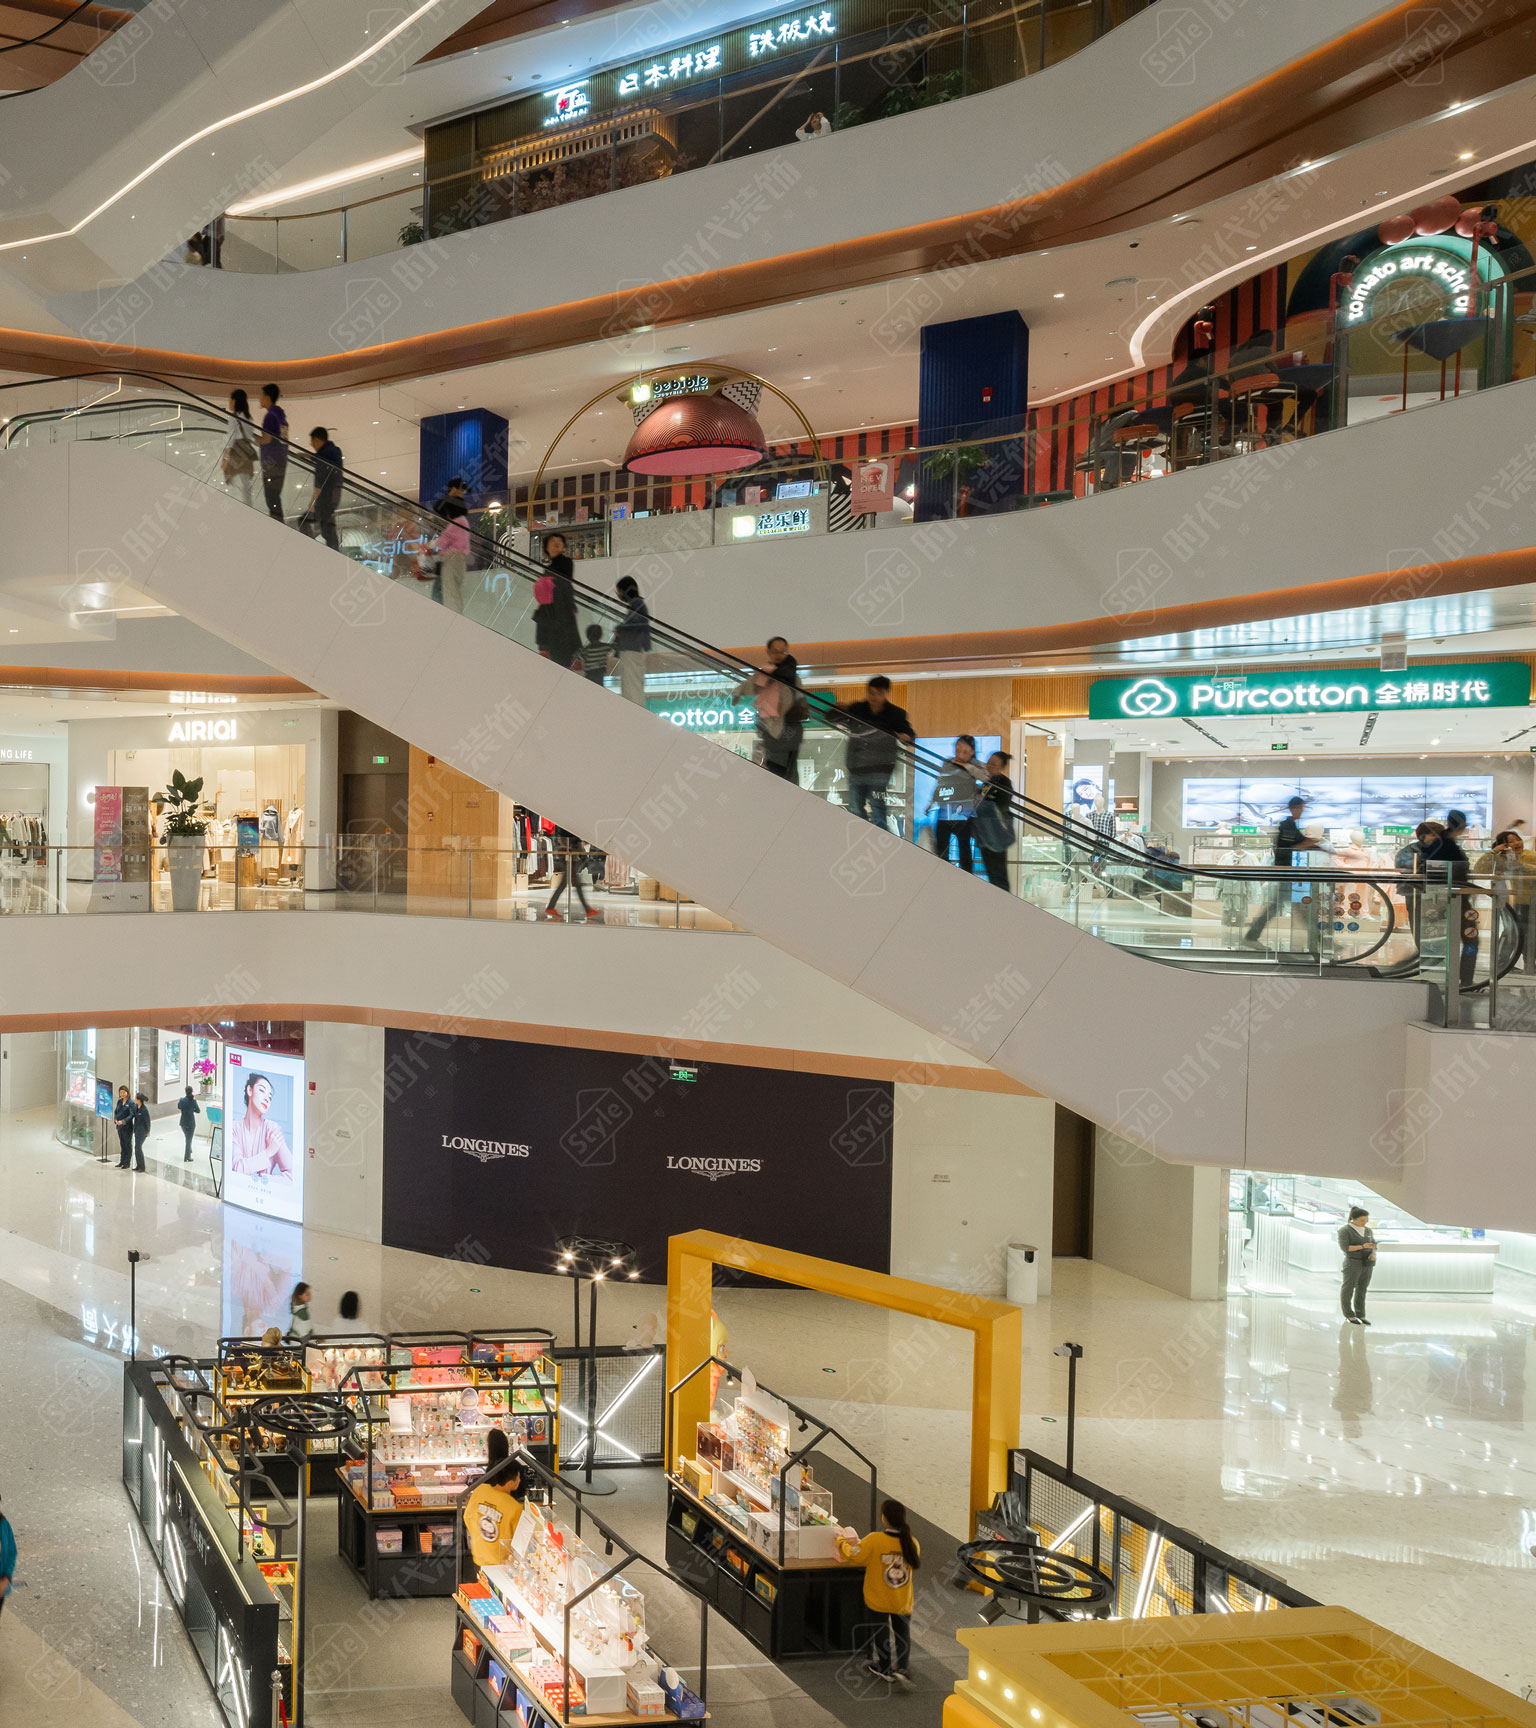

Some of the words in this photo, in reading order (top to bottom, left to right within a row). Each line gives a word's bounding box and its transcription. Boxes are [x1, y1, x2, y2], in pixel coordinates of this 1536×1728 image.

[619, 45, 721, 95] 日本料理
[1349, 261, 1397, 321] tomato
[1399, 254, 1434, 271] art
[1192, 683, 1368, 711] Purcotton
[1375, 681, 1490, 704] 全棉时代
[168, 719, 237, 742] AIRIQI
[15, 749, 33, 760] LIFE
[442, 1135, 530, 1158] LONGINES
[667, 1155, 761, 1173] LONGINES
